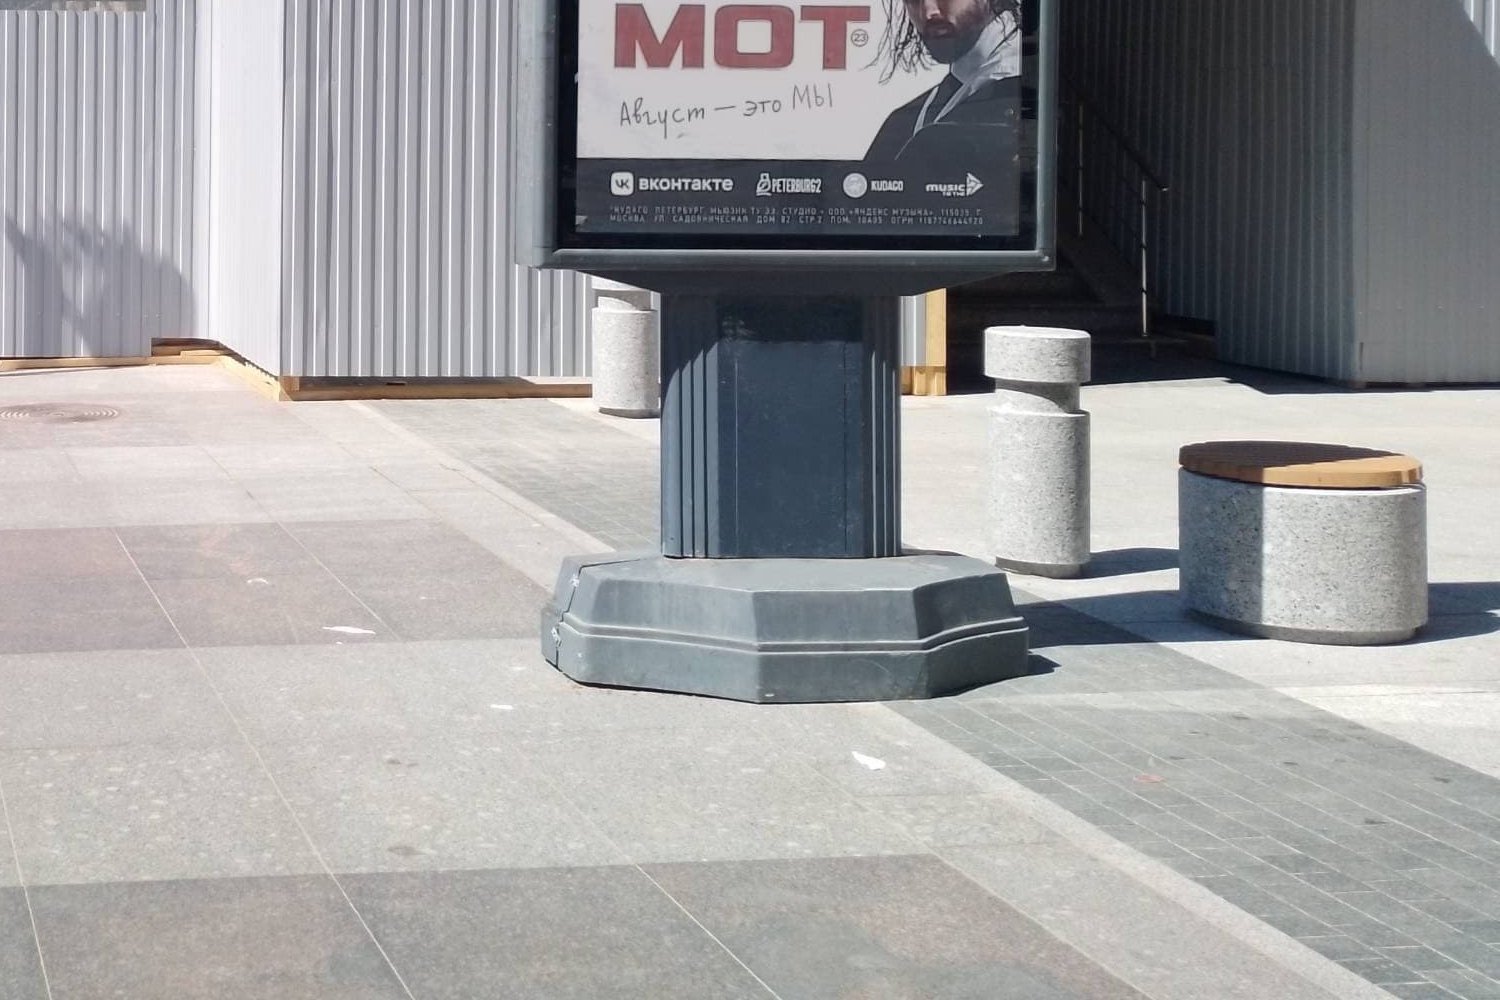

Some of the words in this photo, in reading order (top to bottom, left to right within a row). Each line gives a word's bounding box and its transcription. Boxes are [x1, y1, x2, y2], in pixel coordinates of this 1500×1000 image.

[614, 3, 871, 71] МОТ
[620, 97, 706, 140] Август
[742, 100, 782, 117] это
[792, 83, 833, 110] МЫ
[638, 177, 734, 191] вконтакте
[756, 215, 775, 224] ДОМ
